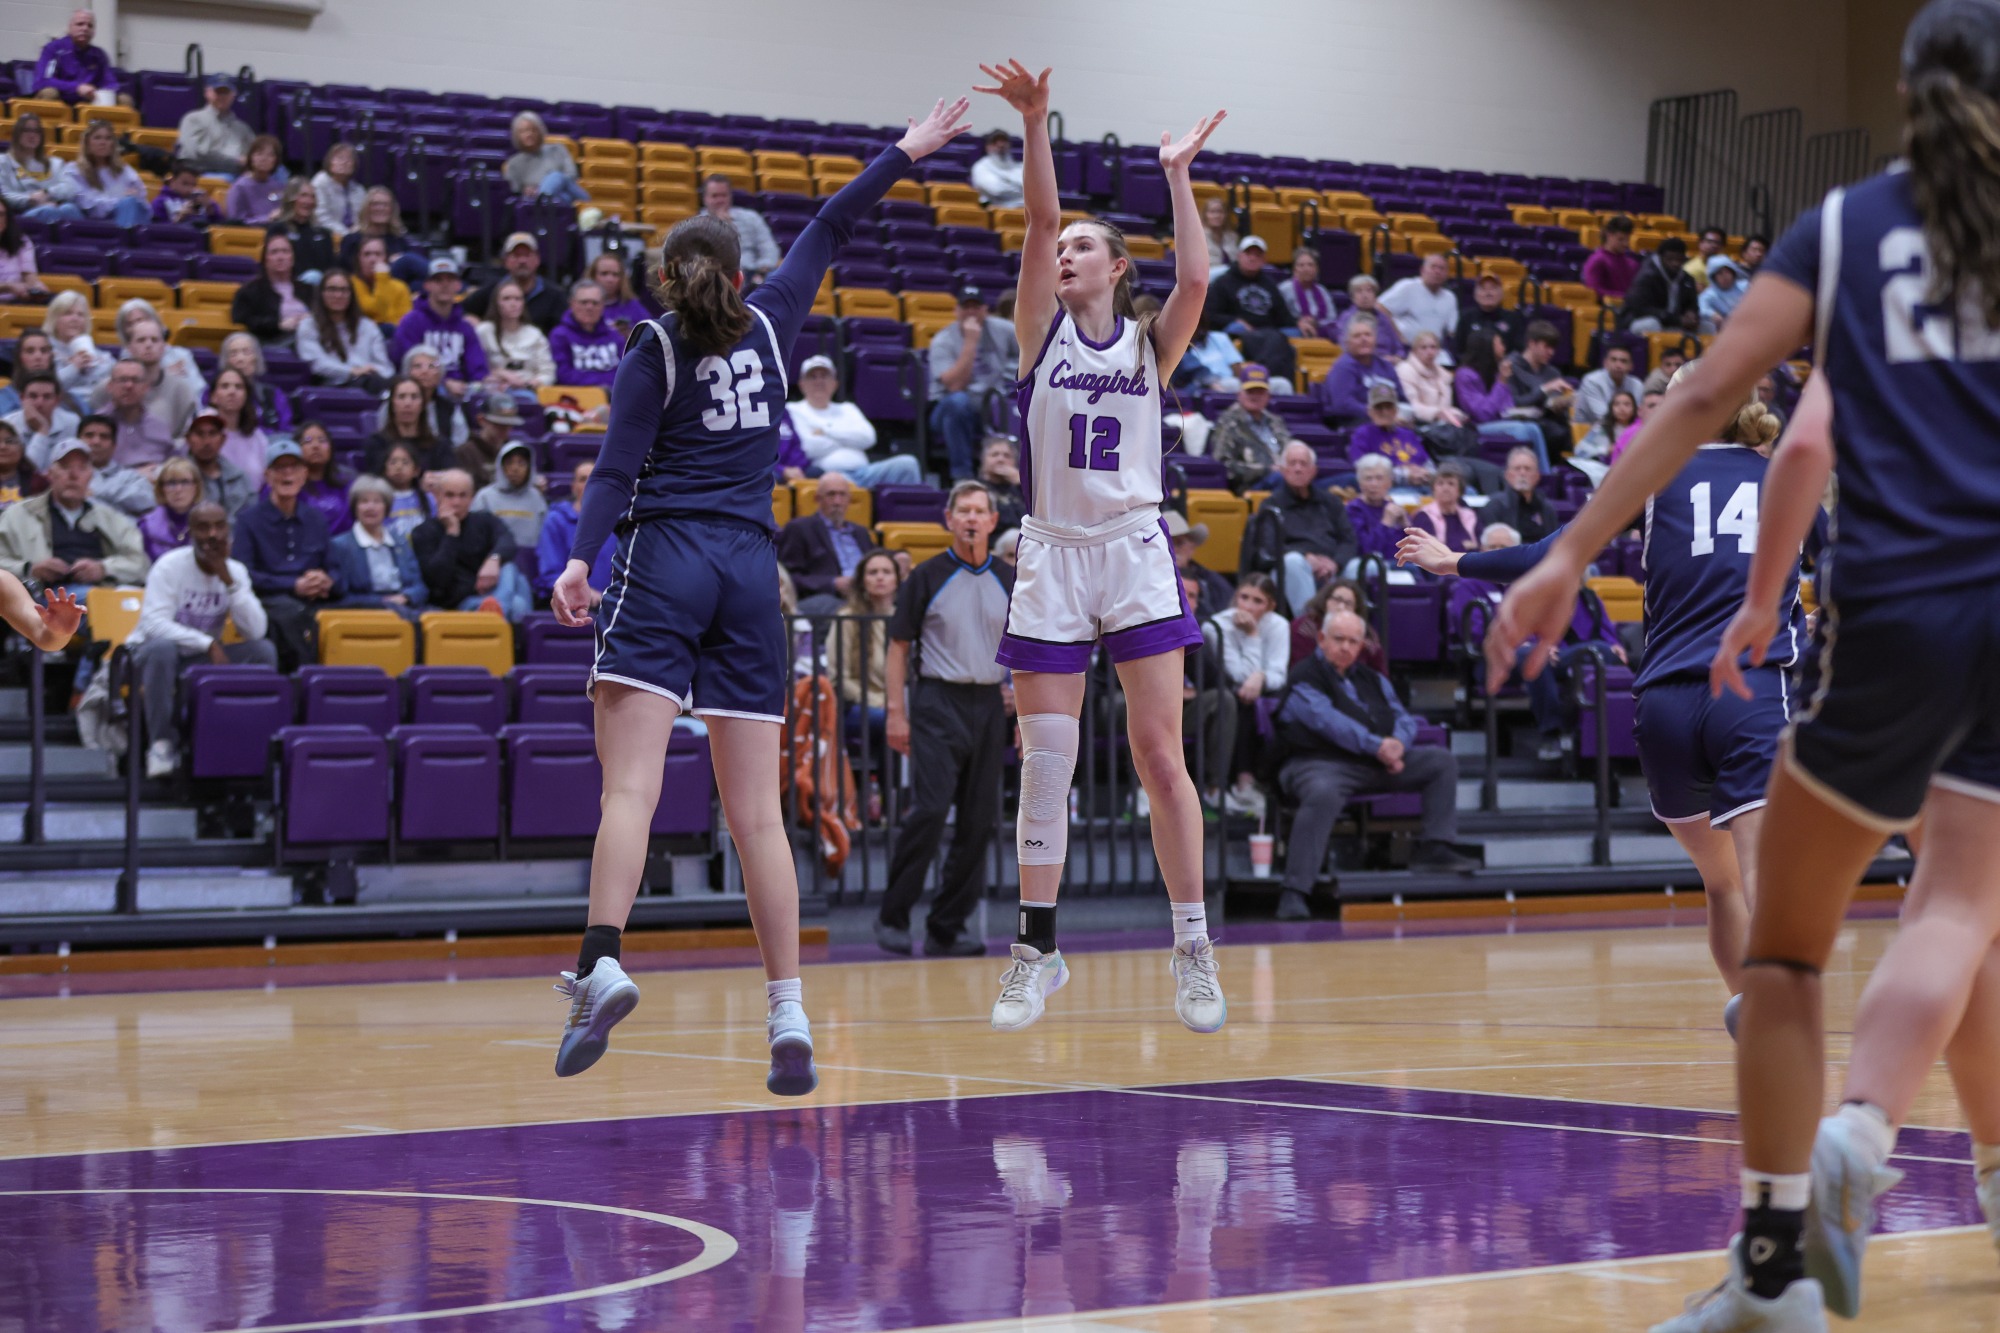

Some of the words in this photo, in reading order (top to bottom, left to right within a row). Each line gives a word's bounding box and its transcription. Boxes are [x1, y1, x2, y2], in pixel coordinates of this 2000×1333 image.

[695, 348, 770, 431] 32
[1049, 359, 1149, 405] Cowgirls
[1068, 413, 1122, 472] 12
[1689, 481, 1760, 557] 14
